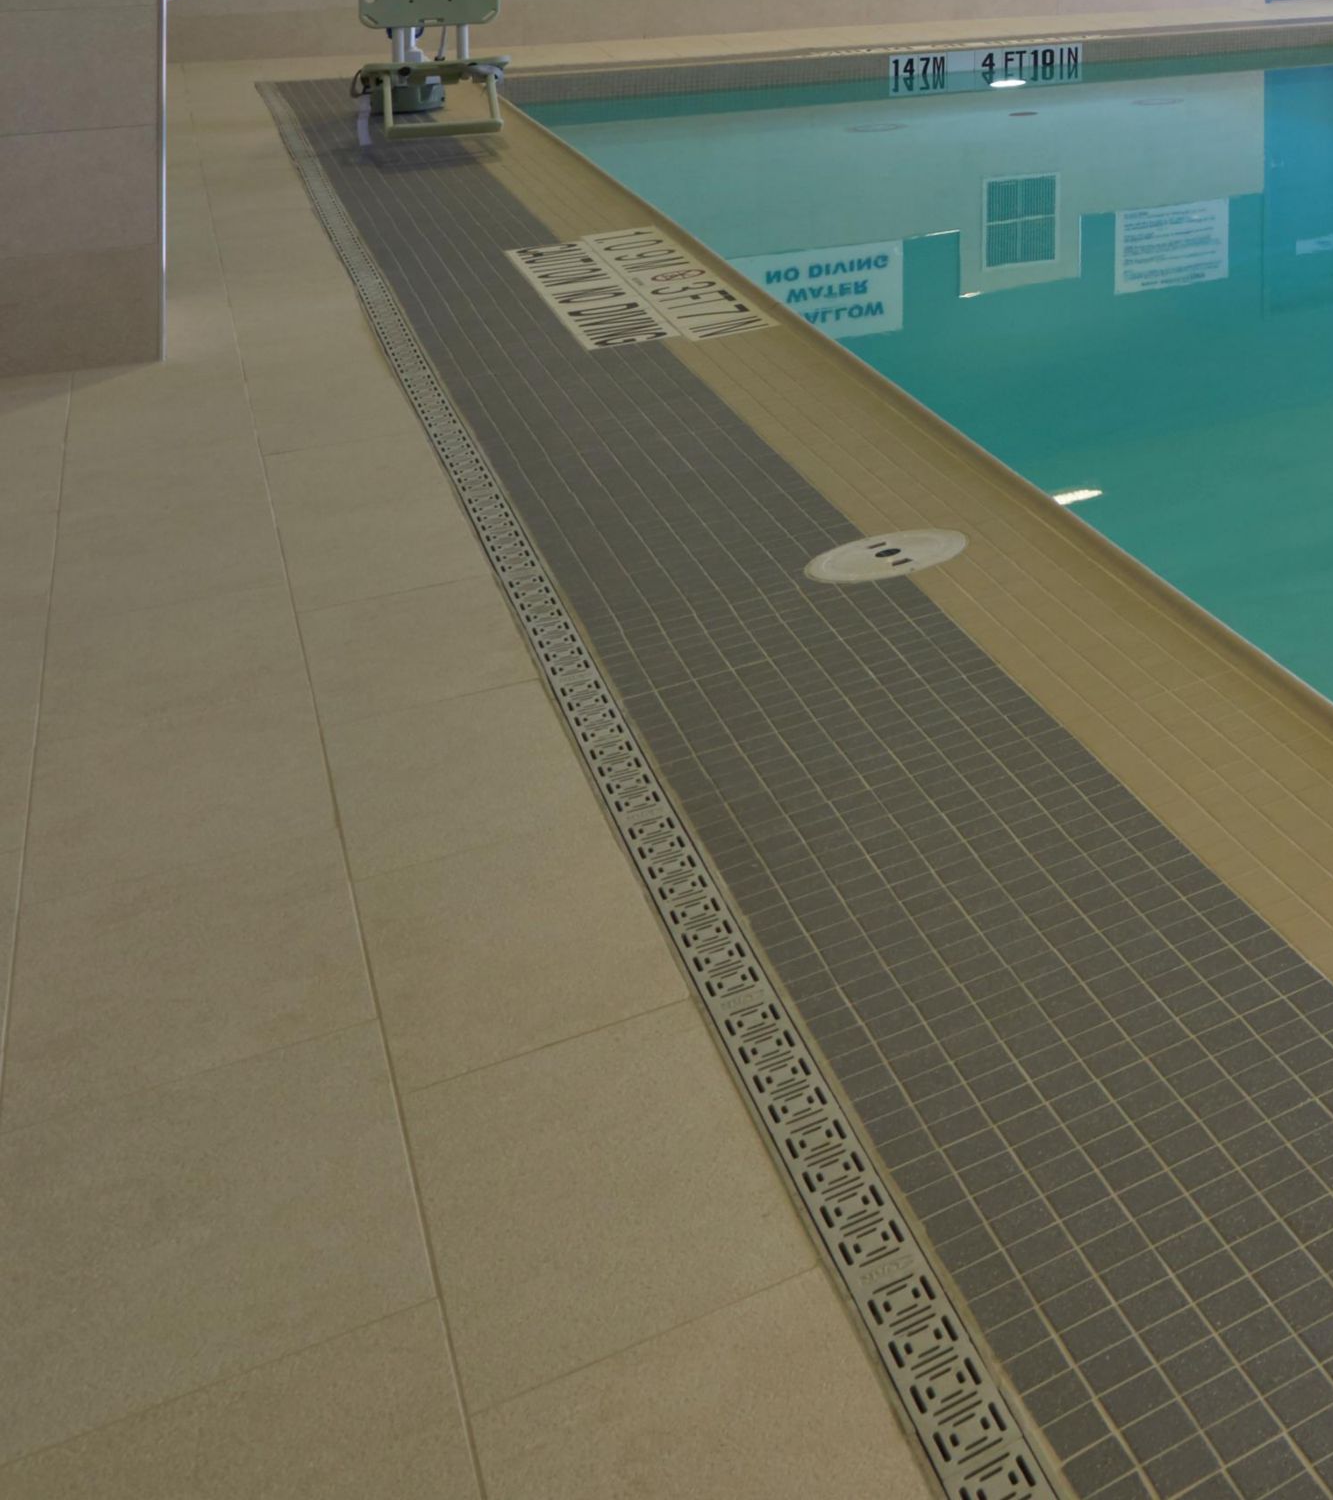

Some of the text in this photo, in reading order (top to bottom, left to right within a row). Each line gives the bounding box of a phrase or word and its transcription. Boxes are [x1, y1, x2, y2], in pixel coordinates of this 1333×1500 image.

[516, 243, 667, 346] CAUTION NO DIVING
